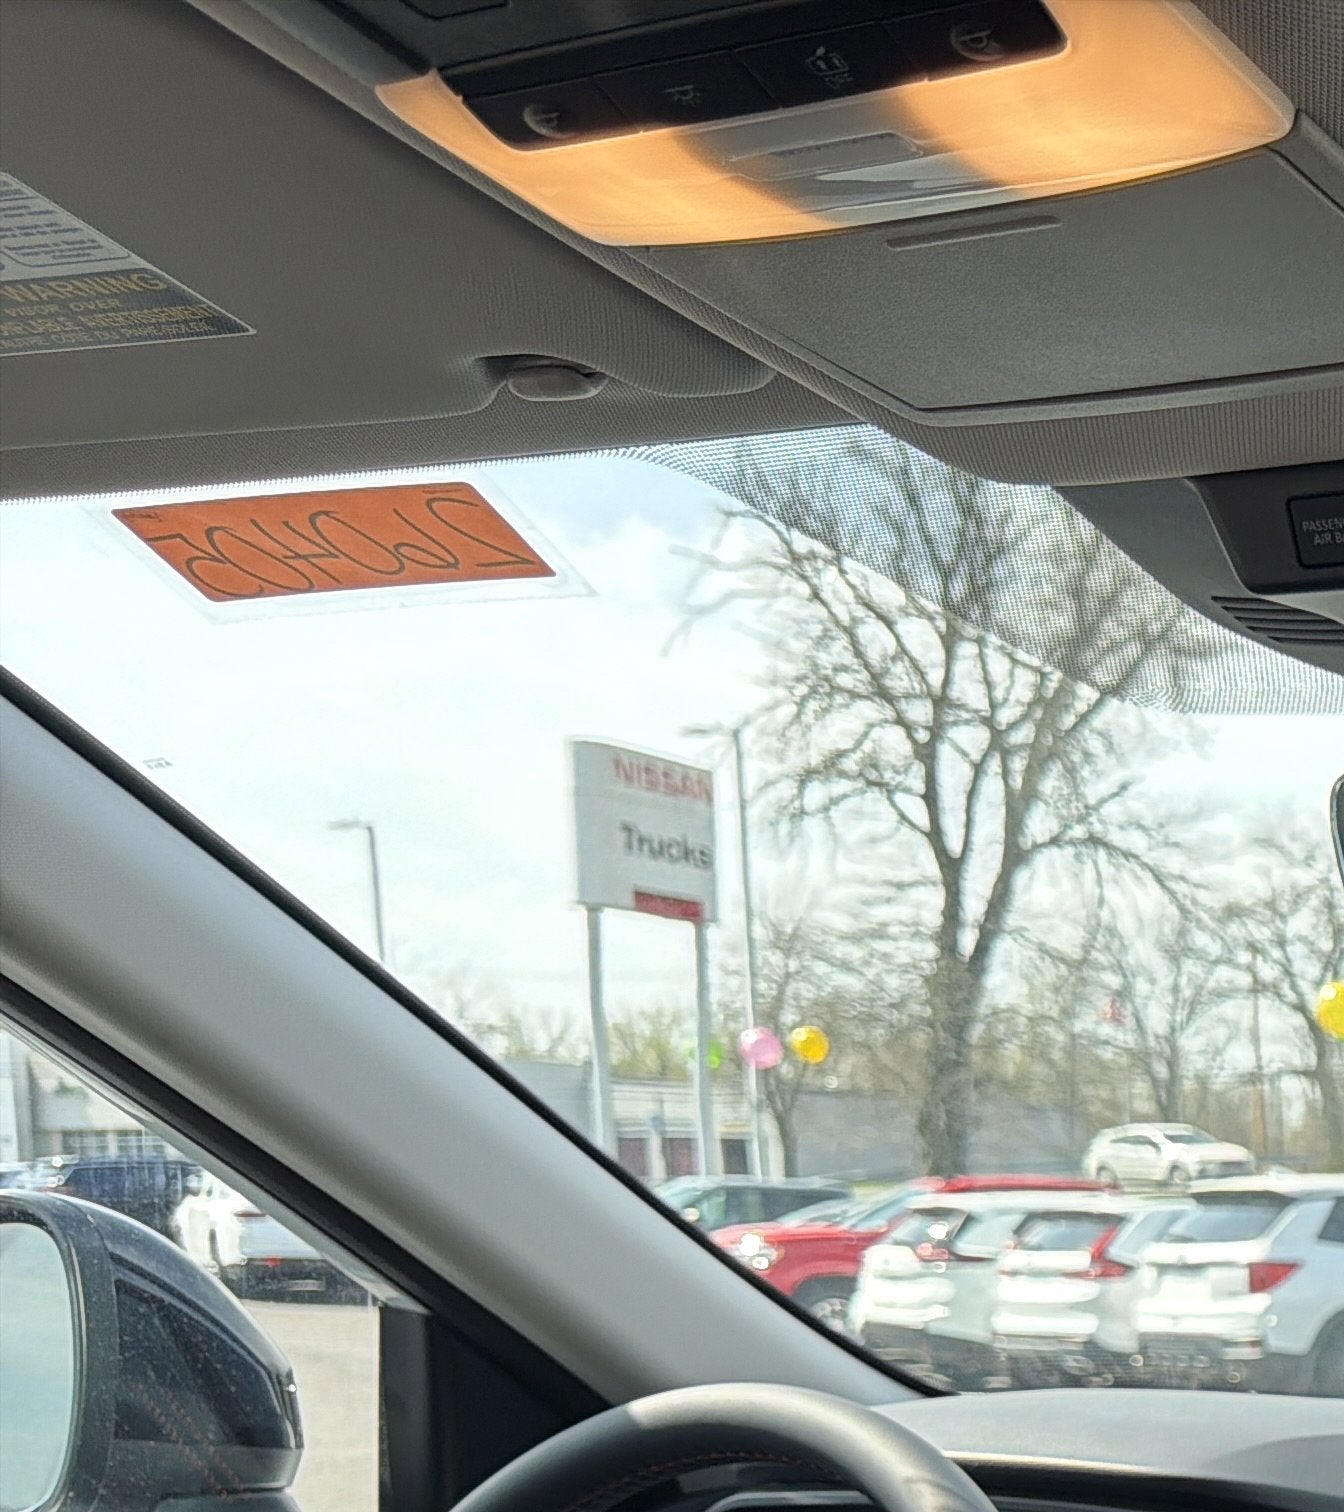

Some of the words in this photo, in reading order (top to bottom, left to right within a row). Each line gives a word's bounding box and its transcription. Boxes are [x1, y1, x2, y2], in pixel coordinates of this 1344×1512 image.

[70, 299, 120, 312] OVER
[1314, 532, 1332, 546] AIR
[612, 753, 713, 807] NISSAN
[618, 820, 713, 871] Trucks
